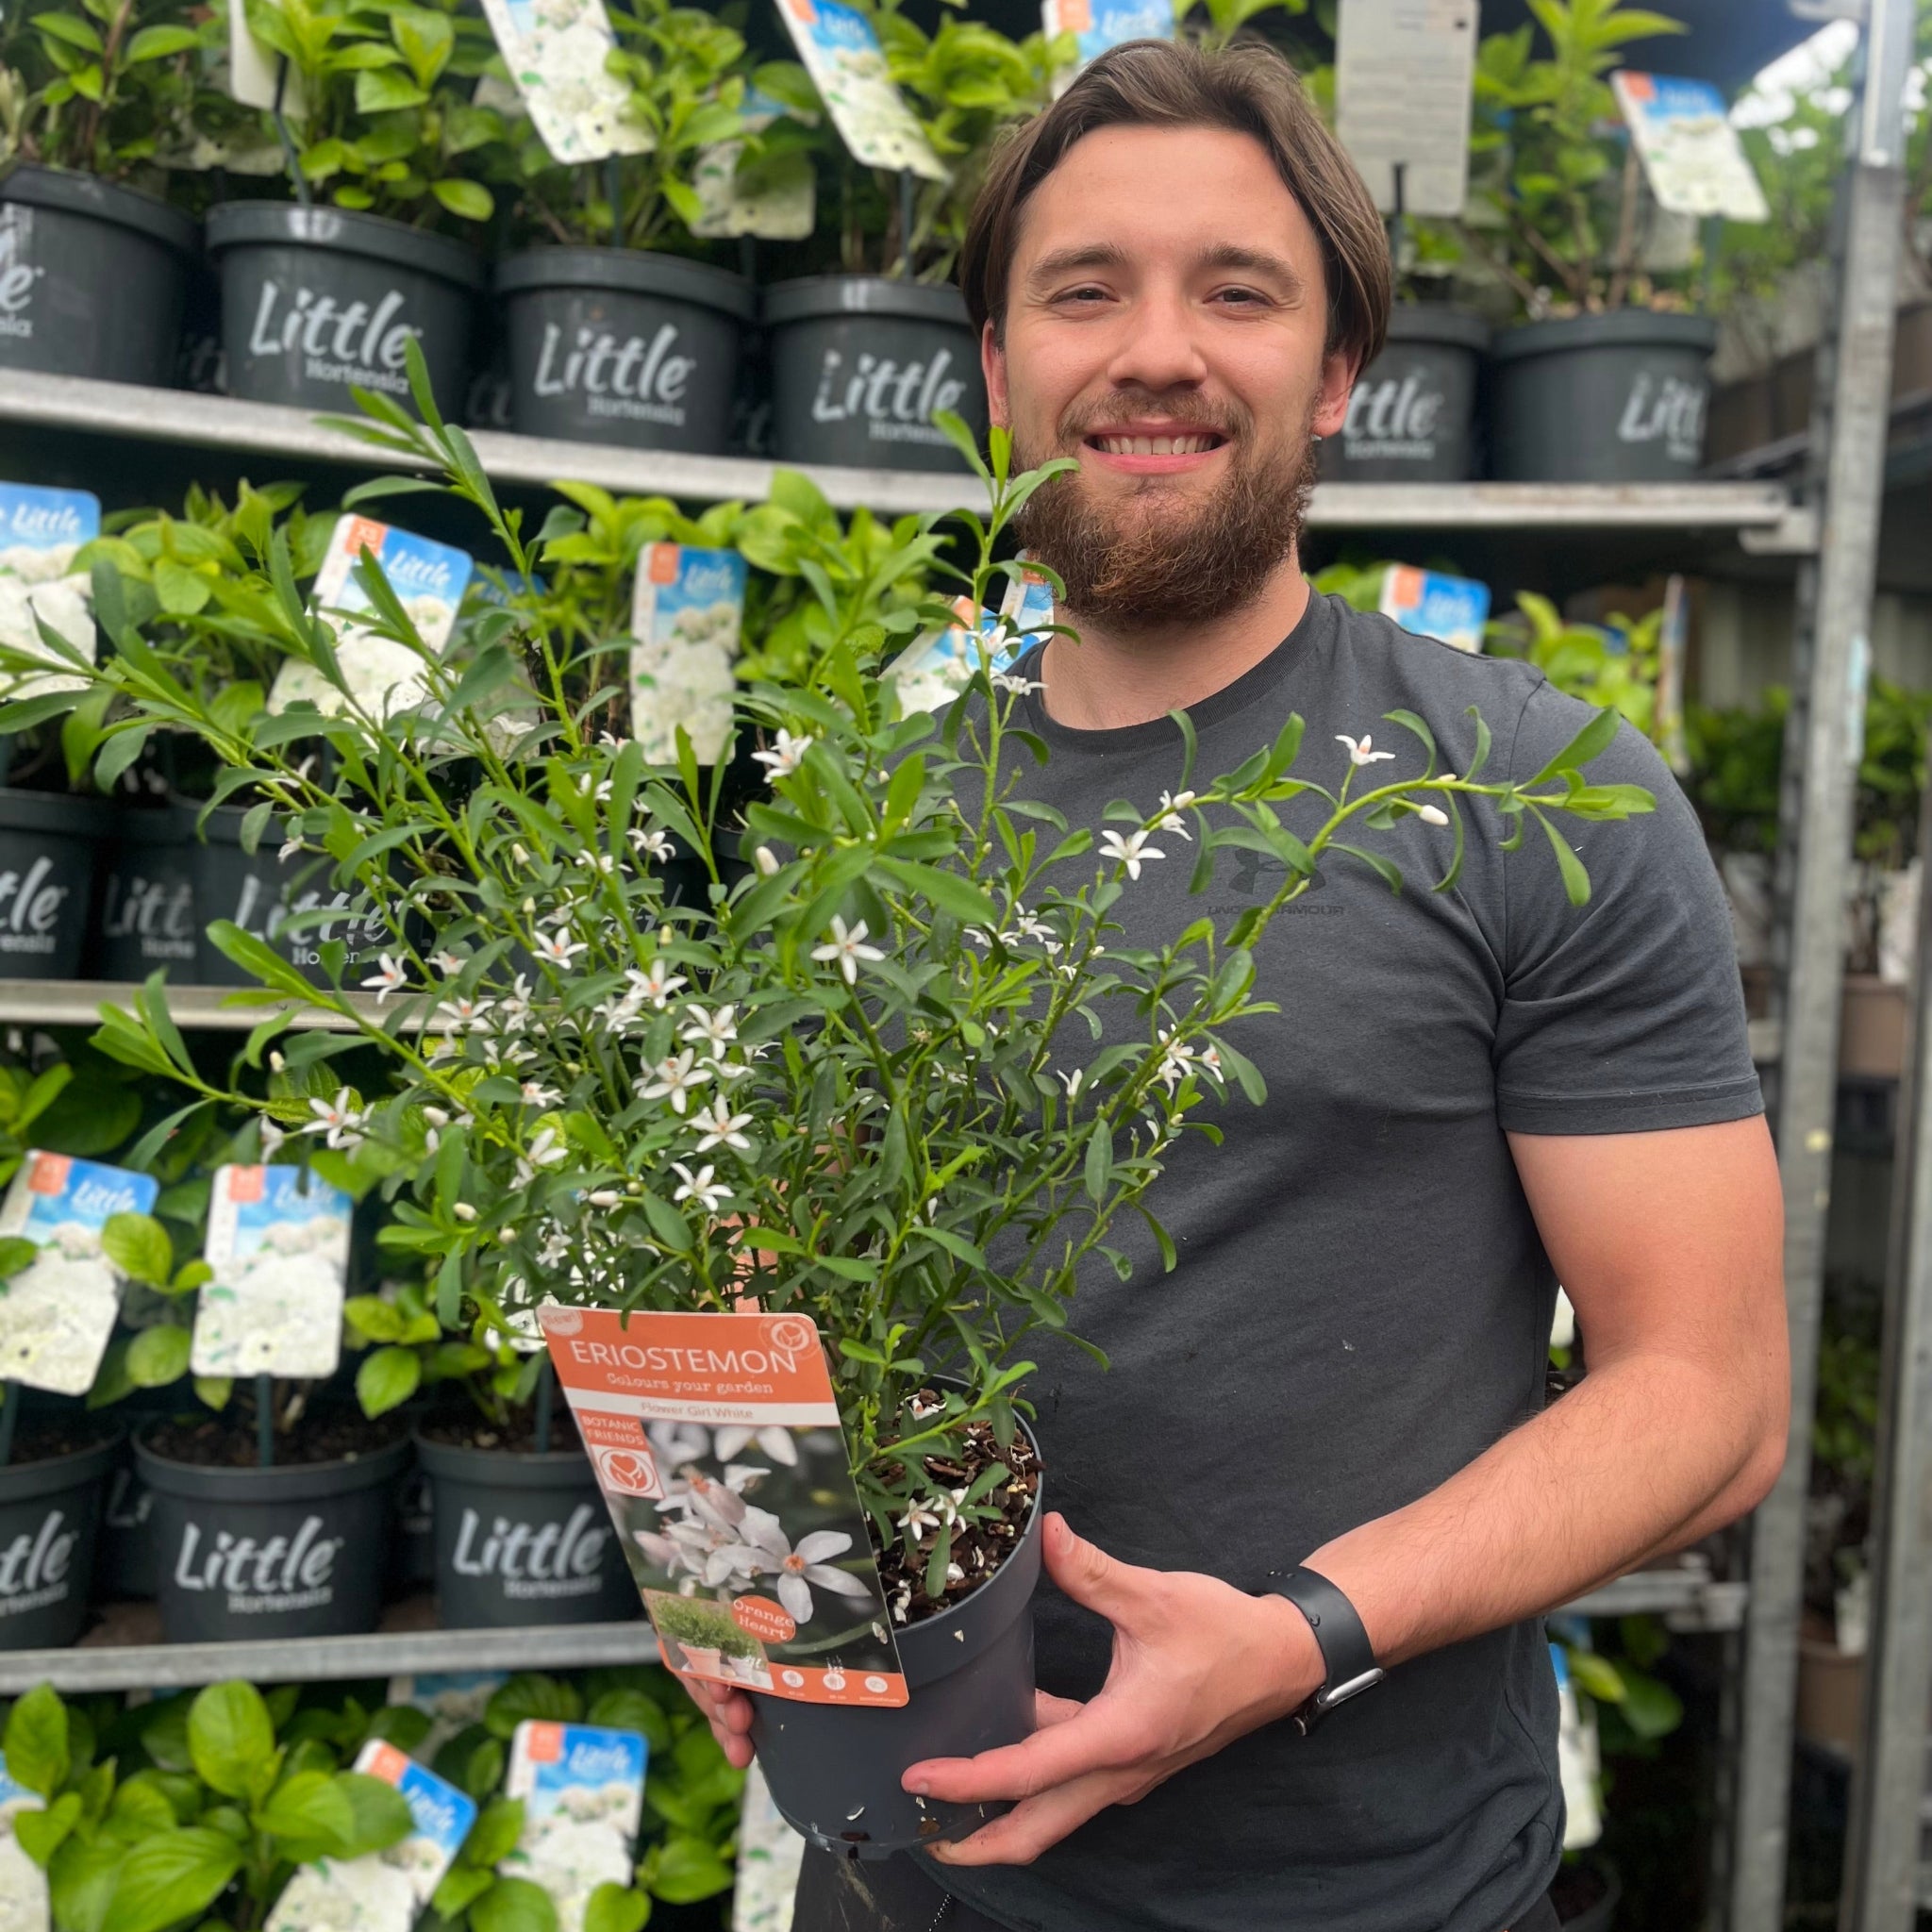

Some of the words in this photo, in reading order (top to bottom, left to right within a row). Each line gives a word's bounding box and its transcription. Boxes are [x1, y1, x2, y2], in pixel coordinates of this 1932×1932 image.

[250, 280, 412, 369] Little
[534, 322, 688, 402] Little
[811, 347, 964, 424] Little
[387, 549, 452, 587] Little
[570, 1341, 797, 1374] ERIOSTEMON
[607, 1372, 670, 1391] Colours
[672, 1380, 711, 1393] your
[717, 1380, 774, 1394] garden
[581, 1415, 640, 1432] BOTANIC
[641, 1402, 684, 1415] Flower
[688, 1406, 711, 1416] Girl
[712, 1406, 754, 1419] White
[587, 1429, 644, 1446] FRIENDS
[175, 1515, 334, 1591] Little
[453, 1503, 605, 1579] Little
[733, 1599, 795, 1627] Orange
[739, 1614, 788, 1641] Heart
